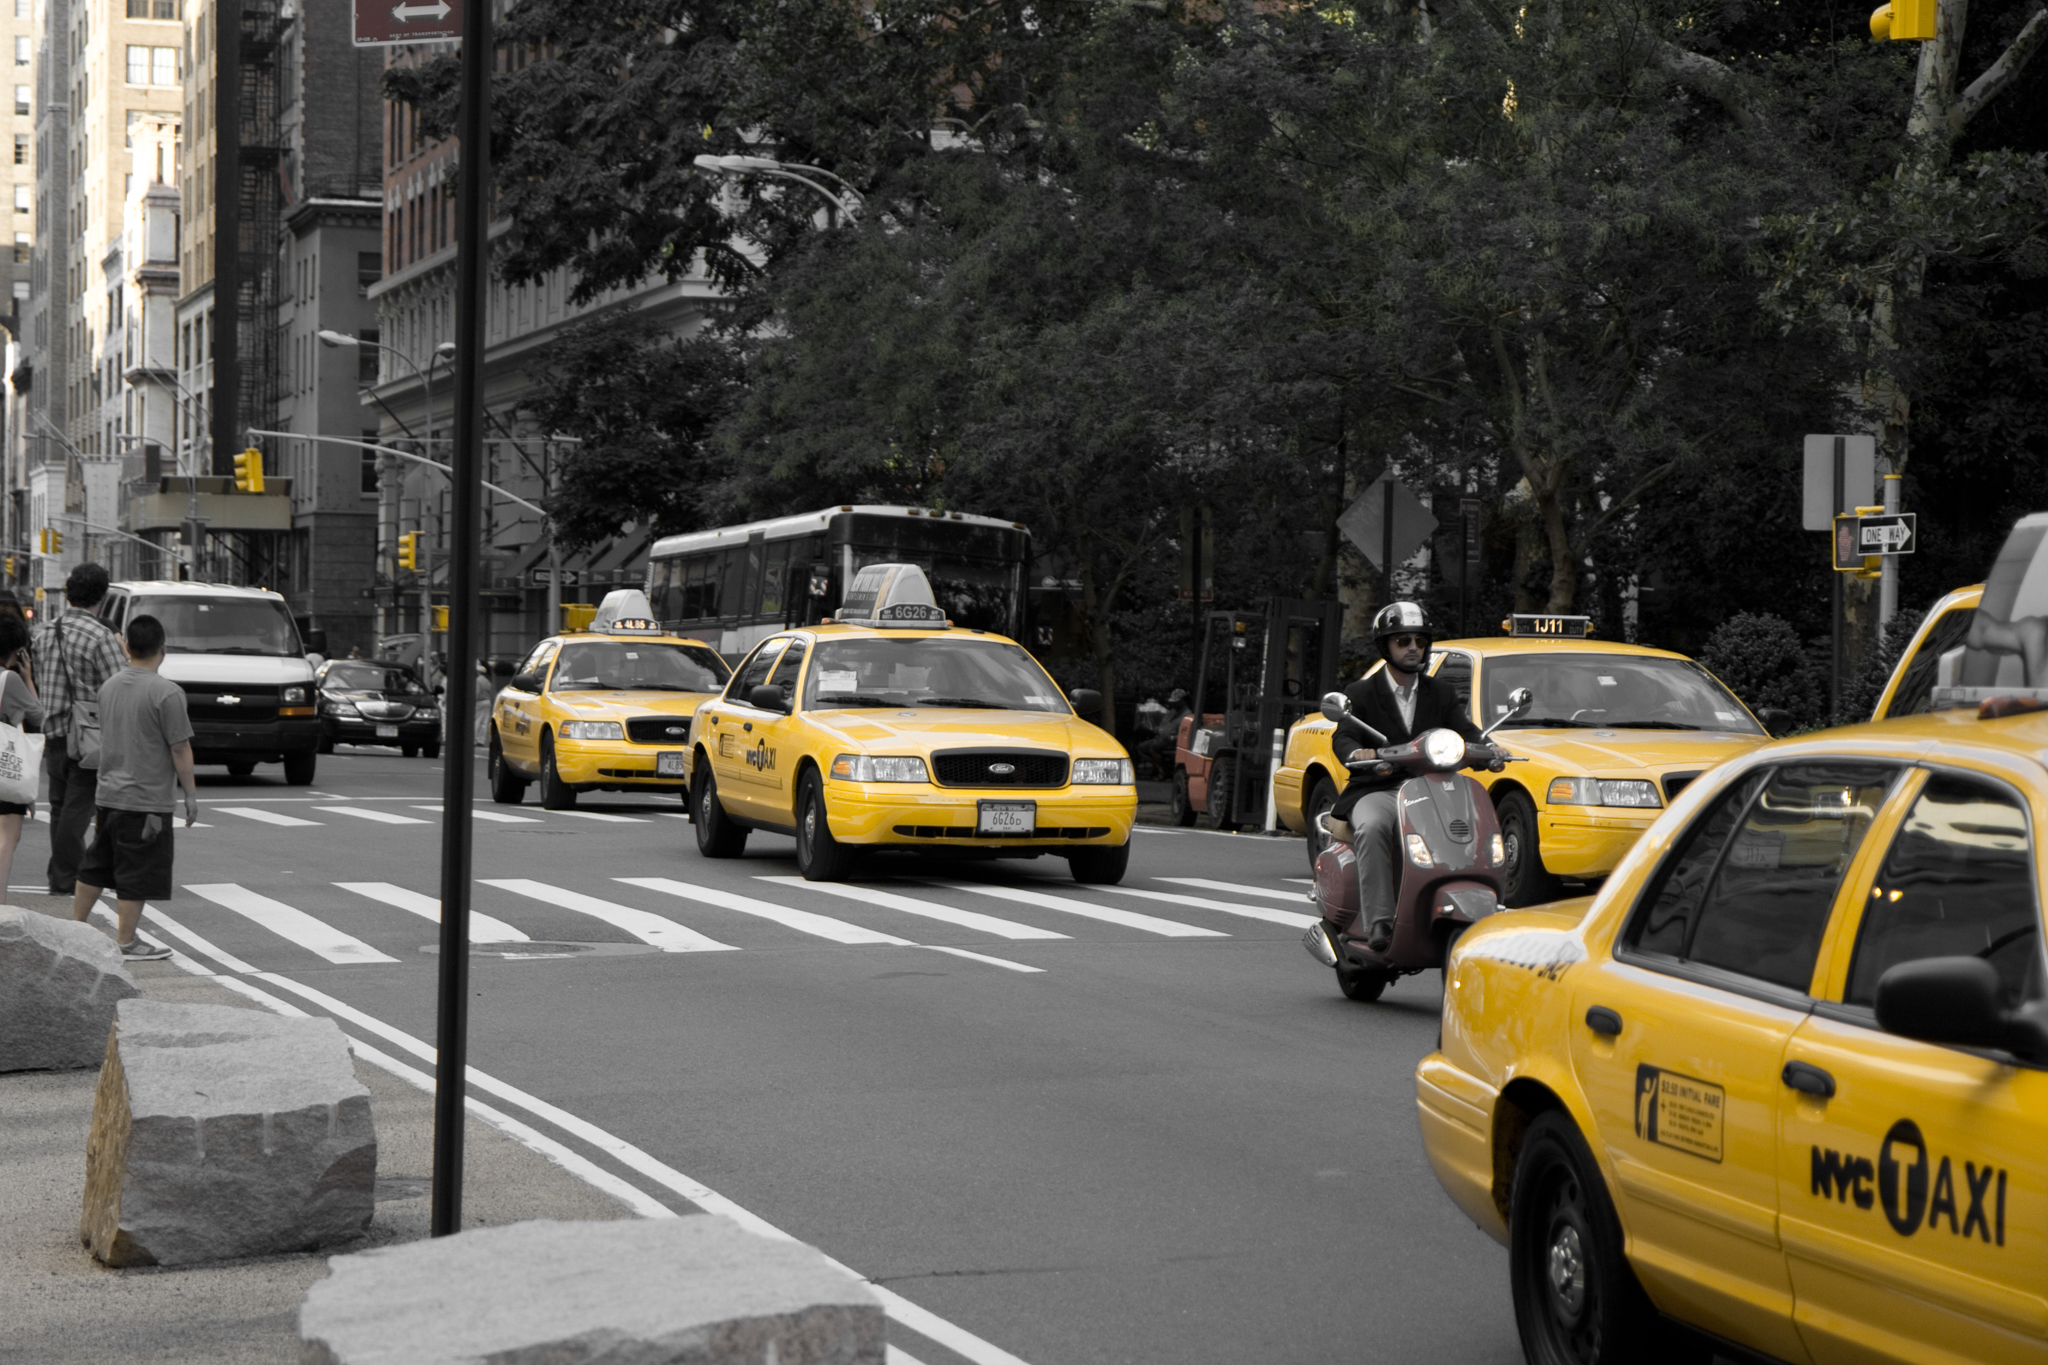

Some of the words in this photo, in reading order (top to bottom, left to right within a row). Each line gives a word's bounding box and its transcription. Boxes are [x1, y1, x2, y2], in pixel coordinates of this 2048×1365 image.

[1866, 528, 1882, 543] ONE
[1888, 527, 1906, 542] WAY
[895, 606, 927, 619] 6G26
[624, 620, 646, 629] 4L85
[1534, 618, 1563, 633] 1J11
[1569, 626, 1583, 634] DUTY
[1811, 1144, 1874, 1211] NYC
[1879, 1118, 2007, 1247] TAXI
